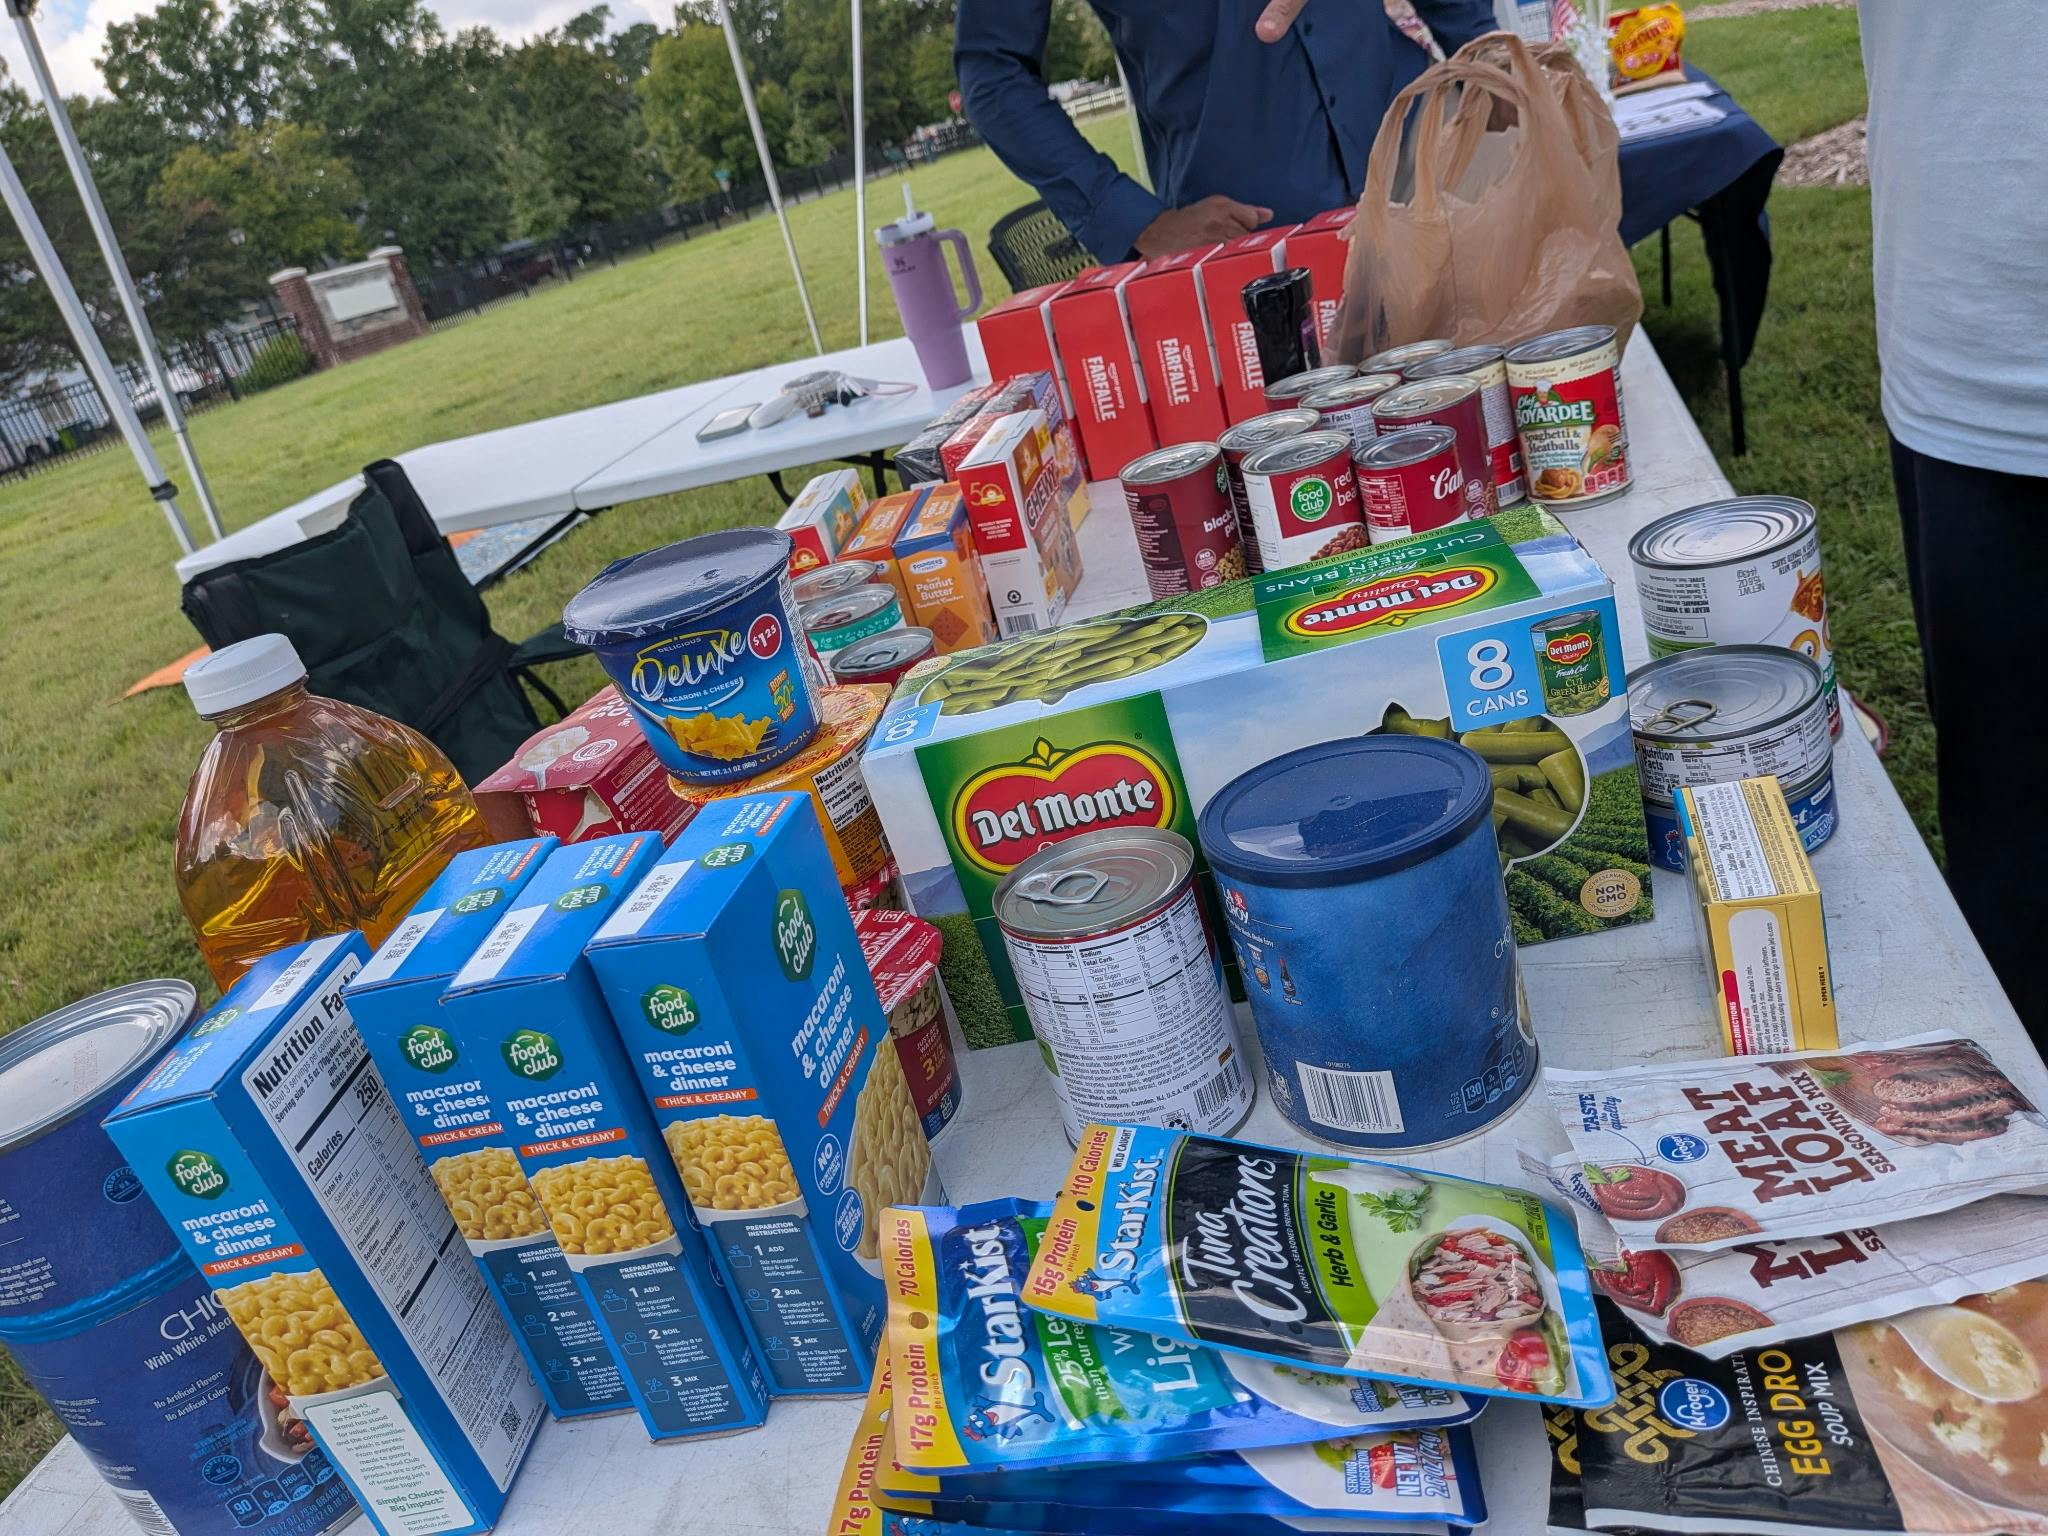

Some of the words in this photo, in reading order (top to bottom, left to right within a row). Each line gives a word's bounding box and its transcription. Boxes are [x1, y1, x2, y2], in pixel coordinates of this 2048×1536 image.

[1237, 321, 1265, 389] FARFALLE
[1162, 338, 1191, 405] FARFALLE
[1087, 356, 1117, 421] FARFALLE
[1516, 400, 1594, 426] BOYARDEE
[1518, 395, 1536, 408] Chef
[1525, 429, 1571, 442] Spaghetti
[1528, 440, 1580, 451] Meatballs
[1334, 467, 1352, 489] red
[1298, 490, 1324, 502] food
[1301, 499, 1325, 512] club
[1434, 533, 1486, 552] CUT
[1352, 548, 1428, 572] GREEN
[916, 577, 954, 593] Peanut
[1266, 570, 1339, 594] BEANS
[1352, 579, 1421, 600] Quality
[1420, 574, 1479, 593] Del
[921, 588, 954, 602] Butter
[1303, 591, 1416, 626] Monte
[657, 637, 702, 653] DELICIOUS
[1549, 645, 1564, 657] Del
[1564, 639, 1590, 654] Monte
[631, 629, 746, 701] Deluxe
[1467, 638, 1514, 692] 8
[661, 691, 703, 704] MACARONI
[709, 679, 742, 695] CHEESE
[1550, 684, 1577, 697] GREEN
[1577, 679, 1601, 693] BEANS
[1565, 677, 1585, 688] CUT
[1466, 689, 1530, 718] CANS
[700, 769, 712, 778] NET
[814, 755, 855, 786] Nutrition
[819, 774, 843, 794] Facts
[853, 795, 870, 815] 220
[971, 805, 1038, 848] Del
[1032, 778, 1157, 831] Monte
[704, 844, 731, 869] food
[728, 842, 749, 863] club
[557, 887, 585, 911] food
[580, 883, 601, 904] club
[1595, 882, 1626, 896] NON
[1596, 892, 1627, 904] GMO
[778, 899, 806, 964] food
[792, 923, 816, 975] club
[648, 993, 688, 1019] food
[791, 952, 845, 1059] macaroni
[661, 1010, 695, 1029] club
[801, 1054, 818, 1079] &
[814, 984, 853, 1058] cheese
[1728, 1001, 1743, 1038] DIRECTIONS
[252, 1014, 326, 1100] Nutrition
[407, 1032, 445, 1060] food
[420, 1048, 453, 1069] club
[510, 1037, 549, 1066] food
[644, 1040, 733, 1064] macaroni
[819, 1016, 856, 1089] dinner
[523, 1054, 558, 1076] club
[652, 1064, 670, 1078] &
[671, 1058, 737, 1078] cheese
[356, 1074, 380, 1110] 250
[669, 1075, 729, 1092] dinner
[1465, 1082, 1483, 1100] 130
[1790, 1071, 1822, 1101] MIX
[506, 1081, 600, 1112] macaroni
[663, 1096, 695, 1107] THICK
[704, 1091, 748, 1103] CREAMY
[275, 1099, 297, 1125] Serving
[415, 1103, 432, 1117] &
[433, 1108, 492, 1129] dinner
[516, 1112, 533, 1127] &
[535, 1101, 604, 1124] cheese
[1583, 1093, 1601, 1133] TASTE
[1604, 1095, 1624, 1131] quality
[427, 1132, 458, 1145] THICK
[534, 1117, 597, 1139] dinner
[1117, 1129, 1134, 1151] CAUGHT
[1734, 1081, 1876, 1195] LOAF
[1818, 1098, 1897, 1175] SEASONING
[307, 1129, 344, 1177] Calories
[528, 1143, 560, 1155] THICK
[571, 1131, 617, 1148] CREAMY
[817, 1142, 834, 1164] NO
[1079, 1130, 1109, 1174] Calories
[1681, 1086, 1815, 1204] MEAT
[175, 1156, 213, 1186] food
[1111, 1149, 1126, 1169] WILD
[191, 1173, 224, 1195] club
[1070, 1174, 1095, 1198] 110
[182, 1199, 270, 1232] macaroni
[1098, 1158, 1162, 1272] StarKist
[1314, 1189, 1339, 1232] Garlic
[193, 1231, 212, 1246] &
[212, 1217, 277, 1242] cheese
[745, 1220, 795, 1233] PREPARATION
[747, 1226, 801, 1238] INSTRUCTIONS:
[1230, 1153, 1308, 1324] Creations
[214, 1234, 273, 1257] dinner
[754, 1244, 764, 1256] 1
[767, 1244, 785, 1253] ADD
[897, 1219, 920, 1281] Calories
[1045, 1218, 1078, 1268] Protein
[1182, 1211, 1236, 1287] Tuna
[1320, 1234, 1342, 1246] &
[210, 1259, 243, 1273] THICK
[252, 1246, 295, 1265] CREAMY
[618, 1261, 669, 1274] PREPARATION
[1322, 1248, 1355, 1288] Herb
[621, 1265, 676, 1280] INSTRUCTIONS:
[1032, 1270, 1066, 1297] 15g
[628, 1287, 640, 1298] 1
[643, 1285, 661, 1295] ADD
[899, 1279, 921, 1298] 70
[958, 1222, 1037, 1391] StarKist
[648, 1329, 661, 1340] 2
[662, 1327, 681, 1336] BOIL
[144, 1350, 174, 1372] With
[174, 1332, 208, 1359] White
[1077, 1342, 1095, 1367] our
[670, 1375, 683, 1386] 3
[684, 1375, 700, 1384] MIX
[903, 1343, 931, 1409] Protein
[1052, 1348, 1092, 1391] 25%
[1757, 1345, 1804, 1414] DRO
[1803, 1360, 1834, 1400] MIX
[166, 1384, 197, 1405] Artificial
[195, 1369, 224, 1392] Flavors
[176, 1398, 209, 1419] Artificial
[207, 1383, 231, 1403] Colors
[1676, 1380, 1708, 1428] Kroger
[909, 1413, 938, 1451] 17g
[1824, 1405, 1855, 1448] SOUP
[1393, 1442, 1419, 1465] WT
[1755, 1426, 1783, 1488] CHINESE
[1779, 1420, 1833, 1477] EGG
[848, 1434, 884, 1501] Protein
[1345, 1461, 1359, 1494] SERVING
[1357, 1450, 1373, 1495] SUGGESTION
[1395, 1467, 1422, 1497] NET
[233, 1499, 253, 1516] 90
[376, 1494, 407, 1507] Simple
[389, 1502, 406, 1513] Big
